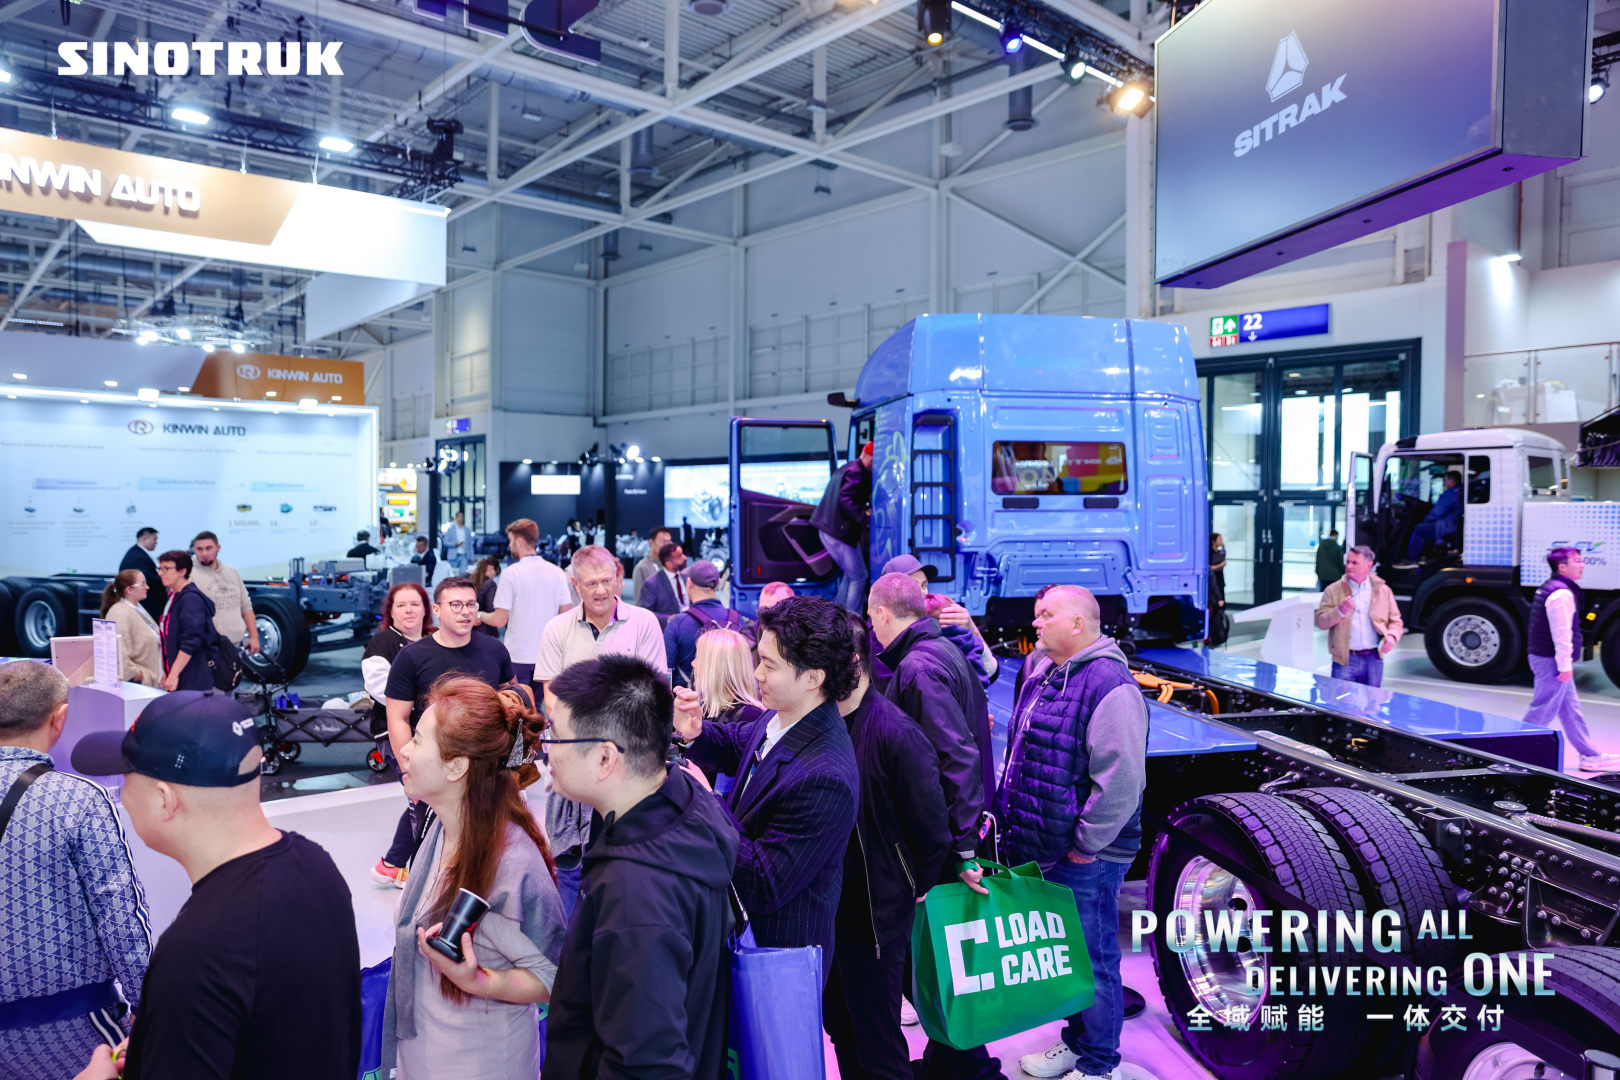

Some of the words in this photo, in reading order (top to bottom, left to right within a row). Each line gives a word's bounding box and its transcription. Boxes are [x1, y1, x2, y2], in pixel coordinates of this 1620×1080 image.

[1234, 73, 1347, 157] SITRAK
[111, 173, 201, 212] AUTO
[1243, 313, 1263, 331] 22
[267, 368, 309, 382] KINWIN
[312, 372, 343, 385] AUTO
[163, 423, 209, 435] KINWIN
[213, 426, 246, 436] AUTO
[1583, 556, 1607, 566] 00%
[994, 910, 1066, 948] LOAD
[1001, 945, 1072, 986] CARE
